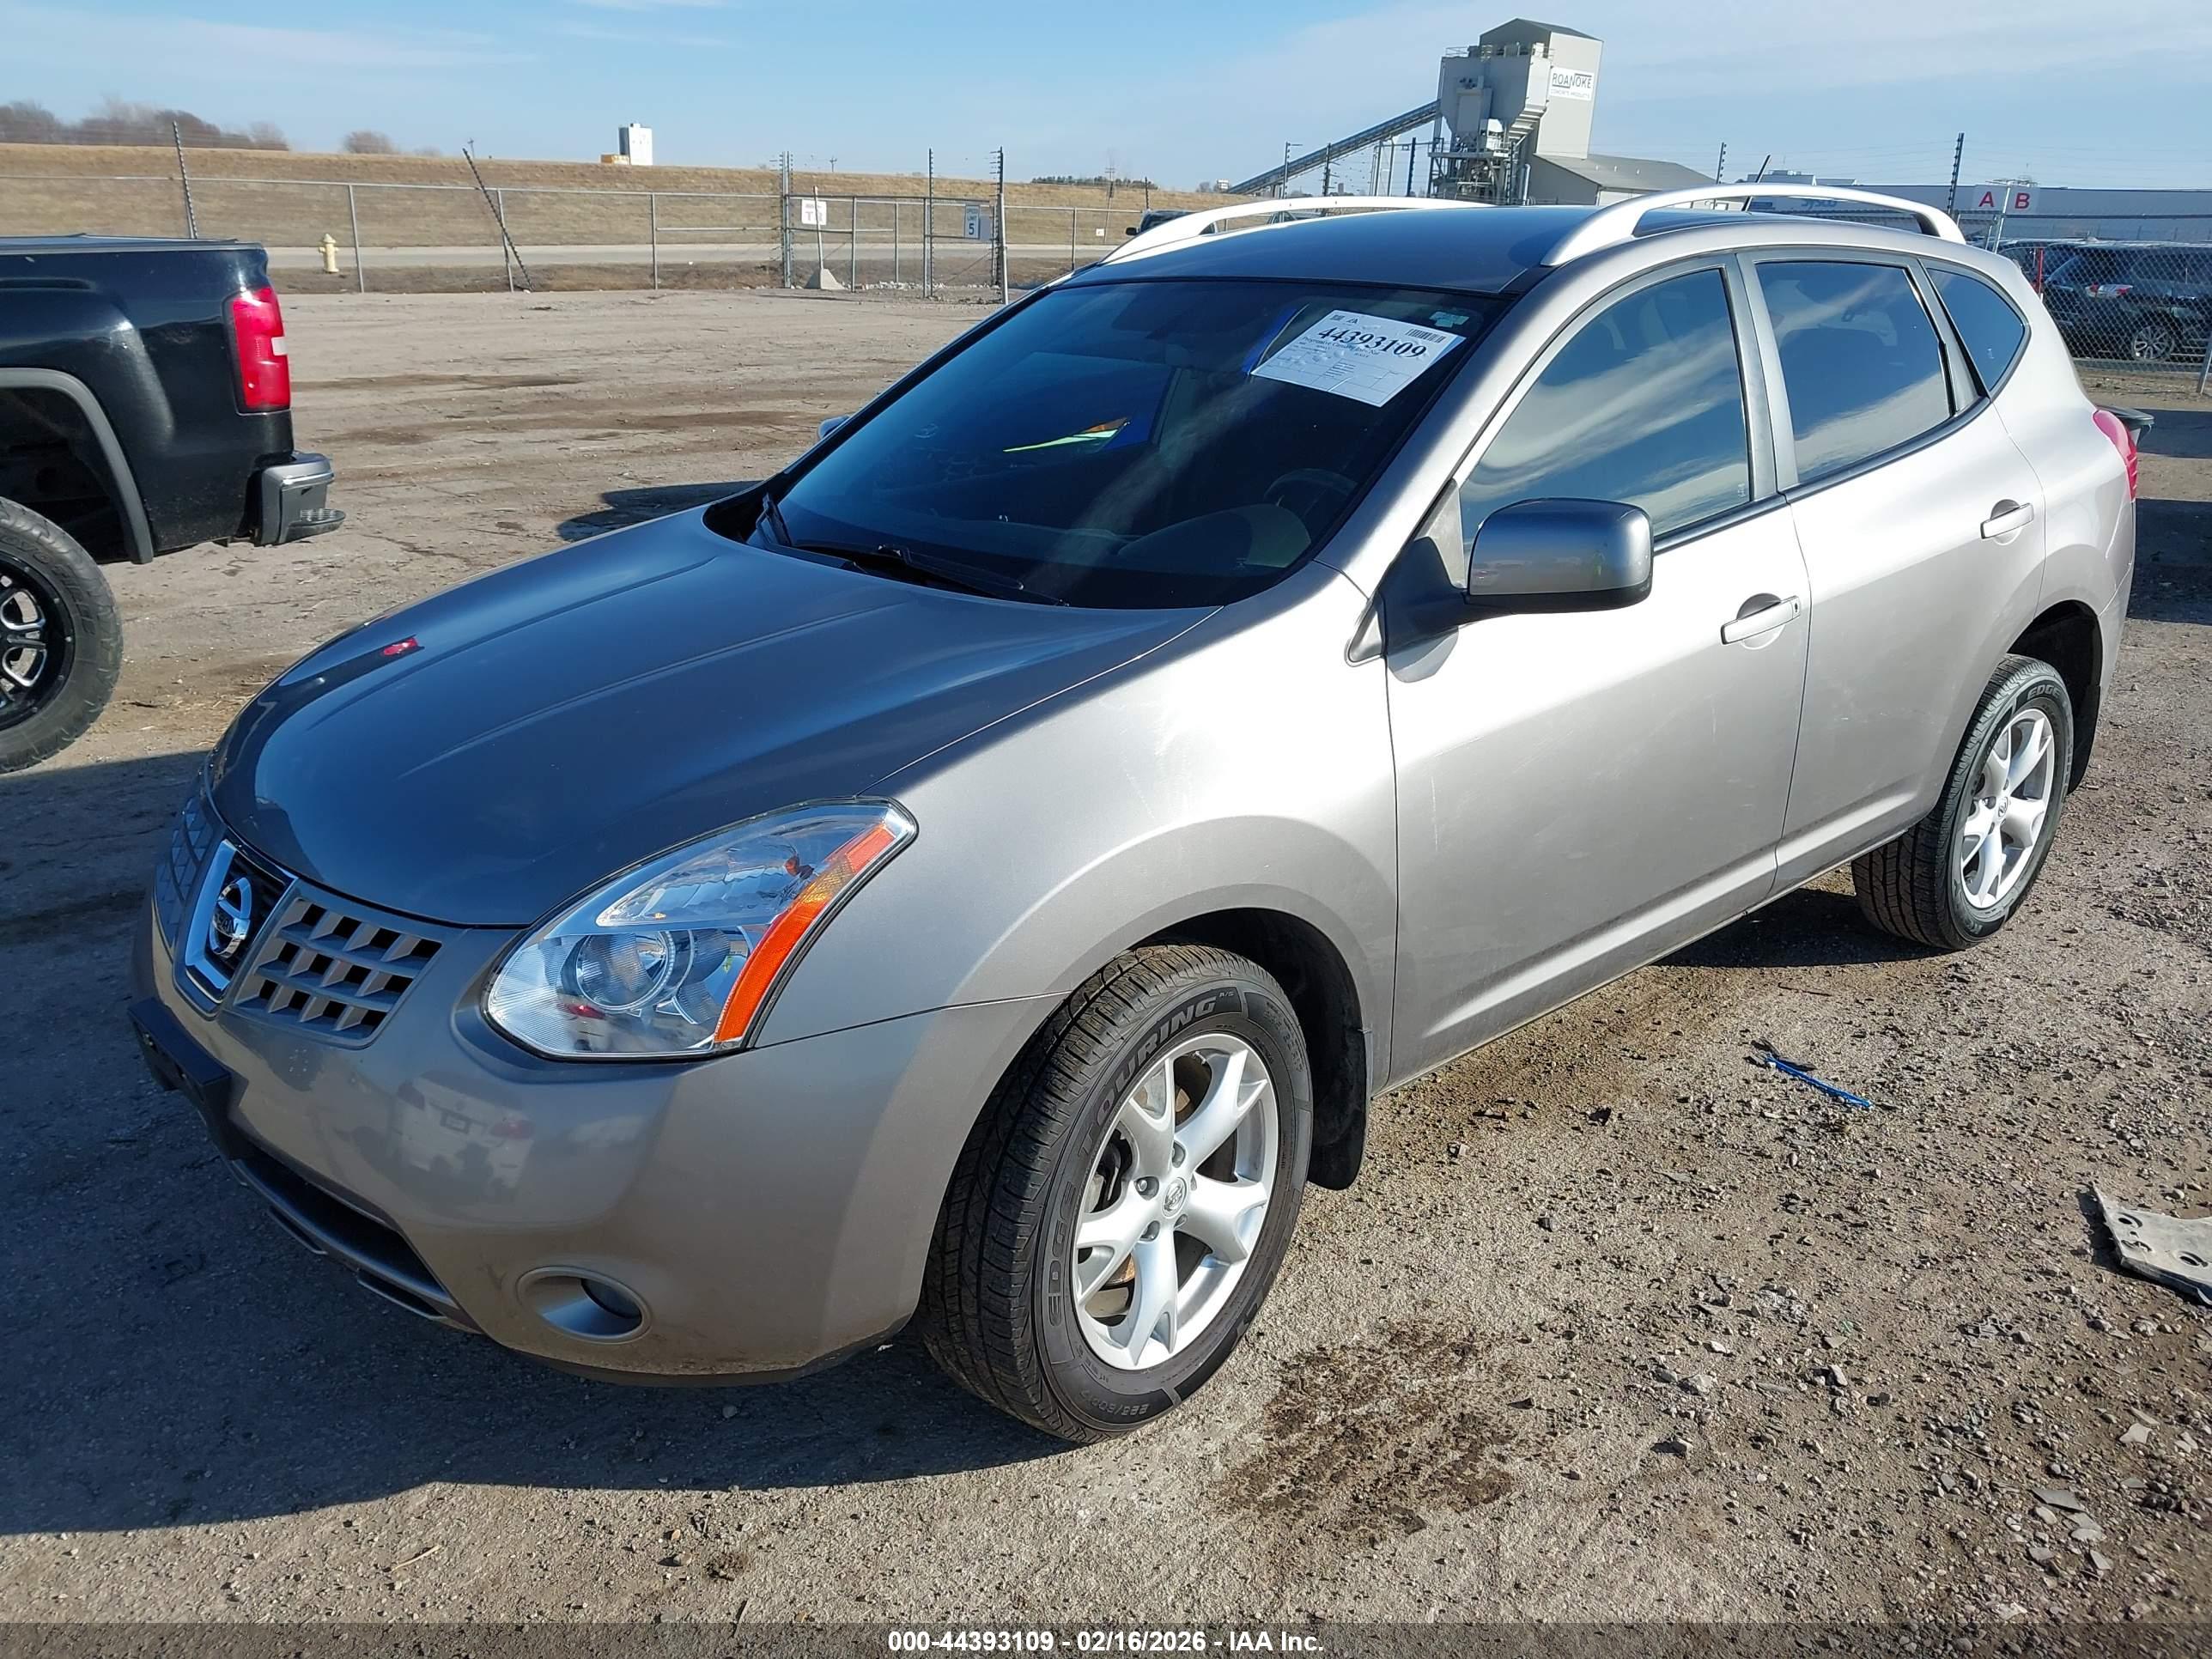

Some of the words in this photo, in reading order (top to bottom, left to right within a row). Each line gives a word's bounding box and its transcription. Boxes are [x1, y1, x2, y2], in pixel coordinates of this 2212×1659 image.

[1553, 72, 1592, 88] ROANOKE
[1978, 191, 1995, 208] A
[2014, 192, 2030, 209] B
[969, 222, 975, 235] 5
[1318, 326, 1427, 358] 44393109
[2027, 684, 2062, 701] EDGE
[1048, 1181, 1077, 1327] EDGE
[1078, 997, 1217, 1158] TOURING
